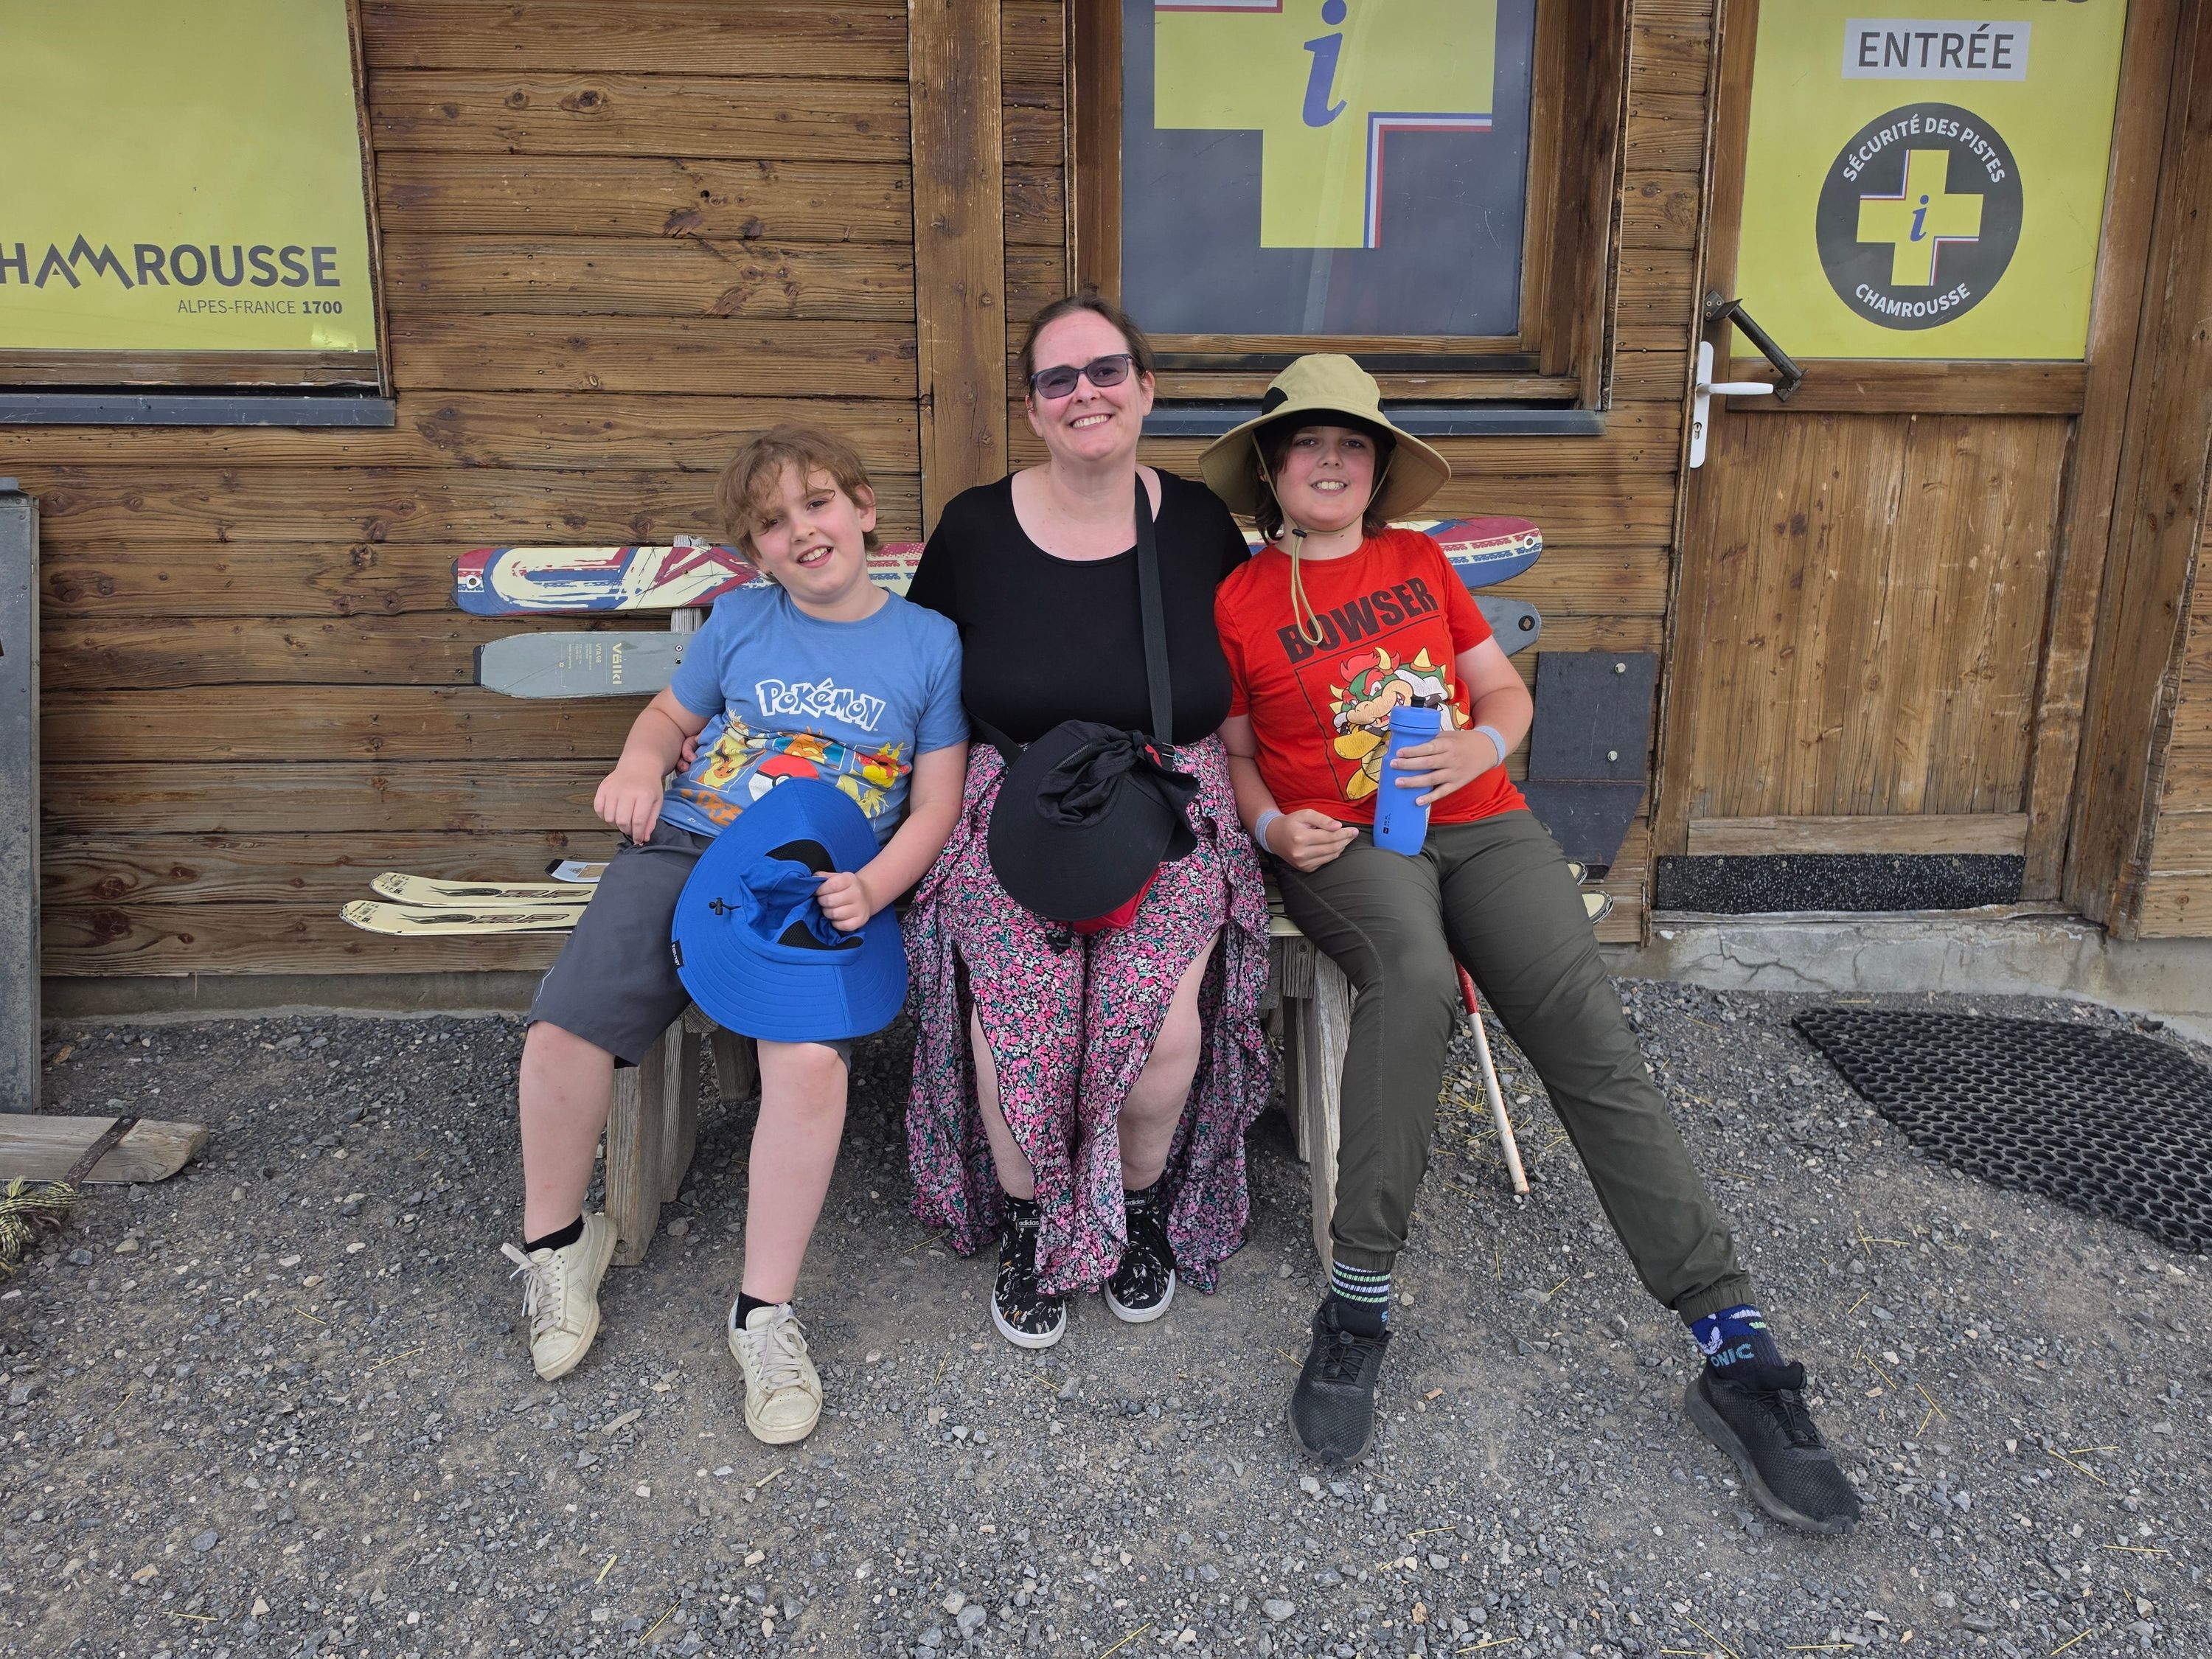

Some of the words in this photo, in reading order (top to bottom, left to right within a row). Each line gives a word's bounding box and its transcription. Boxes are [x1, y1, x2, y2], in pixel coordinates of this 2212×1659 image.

[1858, 24, 2014, 69] ENTRÉE
[1843, 114, 1921, 182] SÉCURITÉ
[1924, 117, 1960, 138] DES
[1960, 127, 2006, 184] PISTES
[0, 233, 341, 290] HAMROUSSE
[178, 299, 296, 315] ALPES-FRANCE
[302, 300, 343, 315] 1700
[1855, 282, 1971, 318] CHAMROUSSE
[1276, 577, 1439, 664] BOWSER
[612, 642, 622, 684] Völkl
[1711, 1343, 1754, 1368] ONIC
